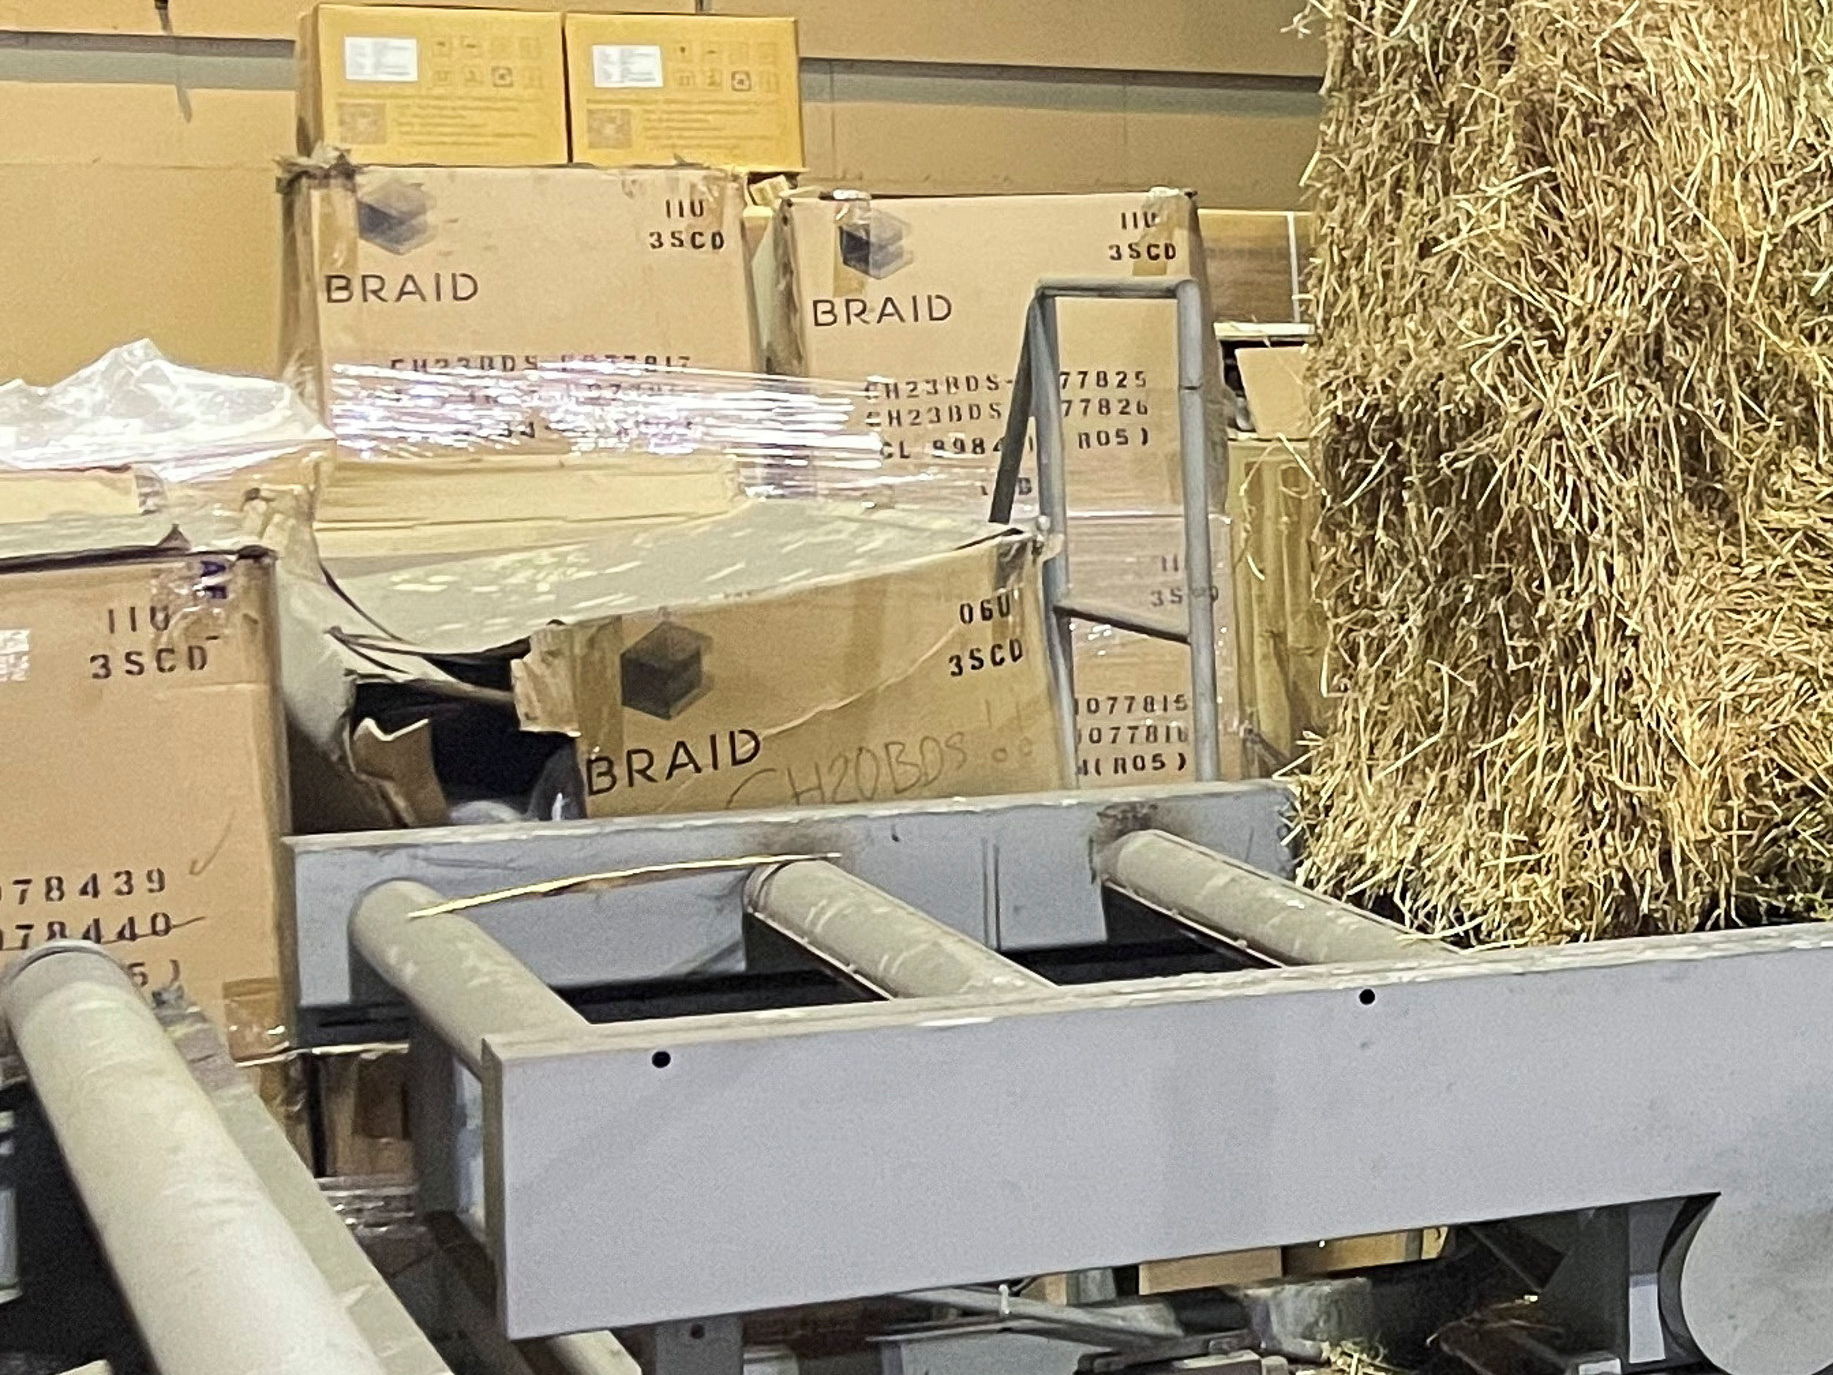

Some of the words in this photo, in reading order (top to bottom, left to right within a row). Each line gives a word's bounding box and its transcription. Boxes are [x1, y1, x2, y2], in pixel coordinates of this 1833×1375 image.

[649, 230, 725, 250] 3SCD
[1108, 241, 1177, 262] 3SCD
[324, 272, 479, 304] BRAID
[811, 293, 953, 327] BRAID
[949, 637, 1024, 677] 3SCD
[585, 728, 762, 797] BRAID
[0, 867, 166, 906] 78439
